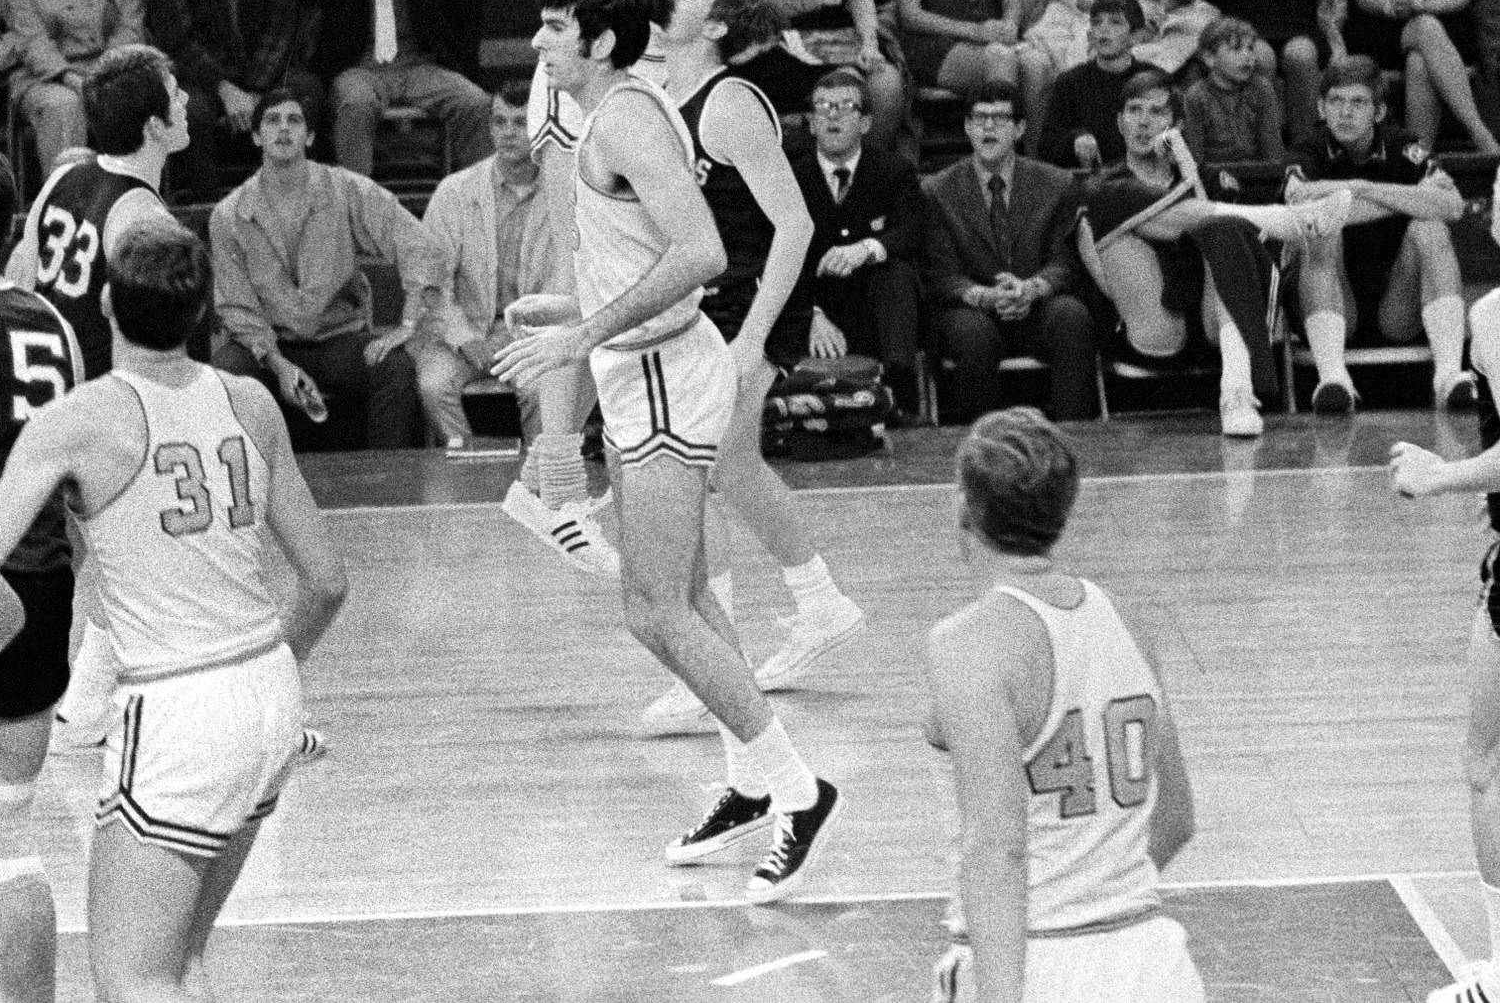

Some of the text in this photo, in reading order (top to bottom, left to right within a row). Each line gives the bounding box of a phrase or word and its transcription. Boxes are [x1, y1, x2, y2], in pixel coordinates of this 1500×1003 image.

[38, 206, 100, 296] 33
[154, 436, 256, 536] 31
[1024, 693, 1156, 819] 40
